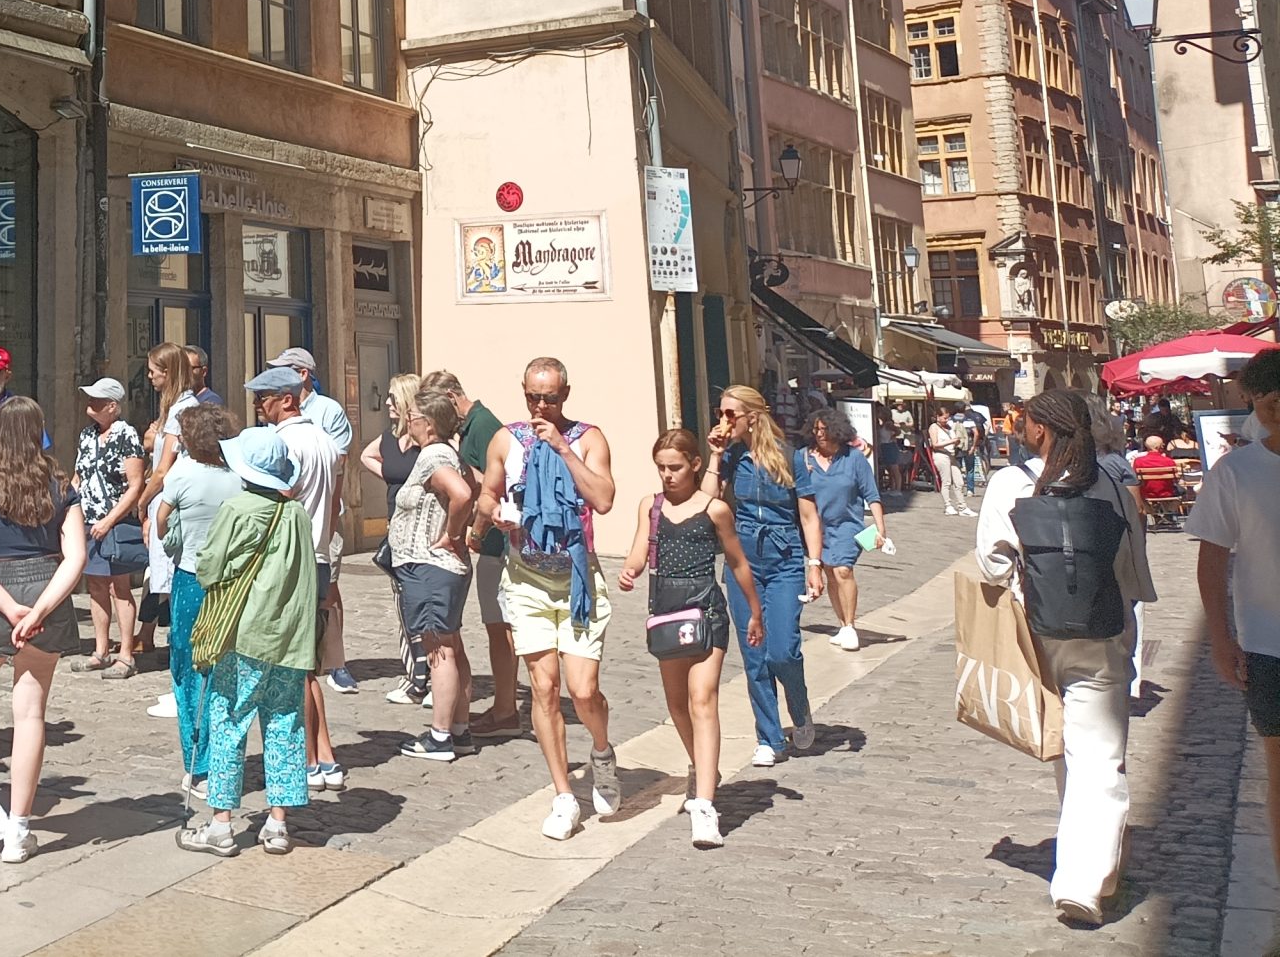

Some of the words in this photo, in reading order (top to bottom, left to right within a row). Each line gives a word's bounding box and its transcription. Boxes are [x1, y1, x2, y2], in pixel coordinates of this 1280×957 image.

[140, 177, 188, 187] CONSERVERIE
[142, 244, 149, 253] la
[150, 243, 190, 253] belle-iloise
[512, 239, 596, 275] Mandragore
[955, 651, 1042, 747] ZARA
